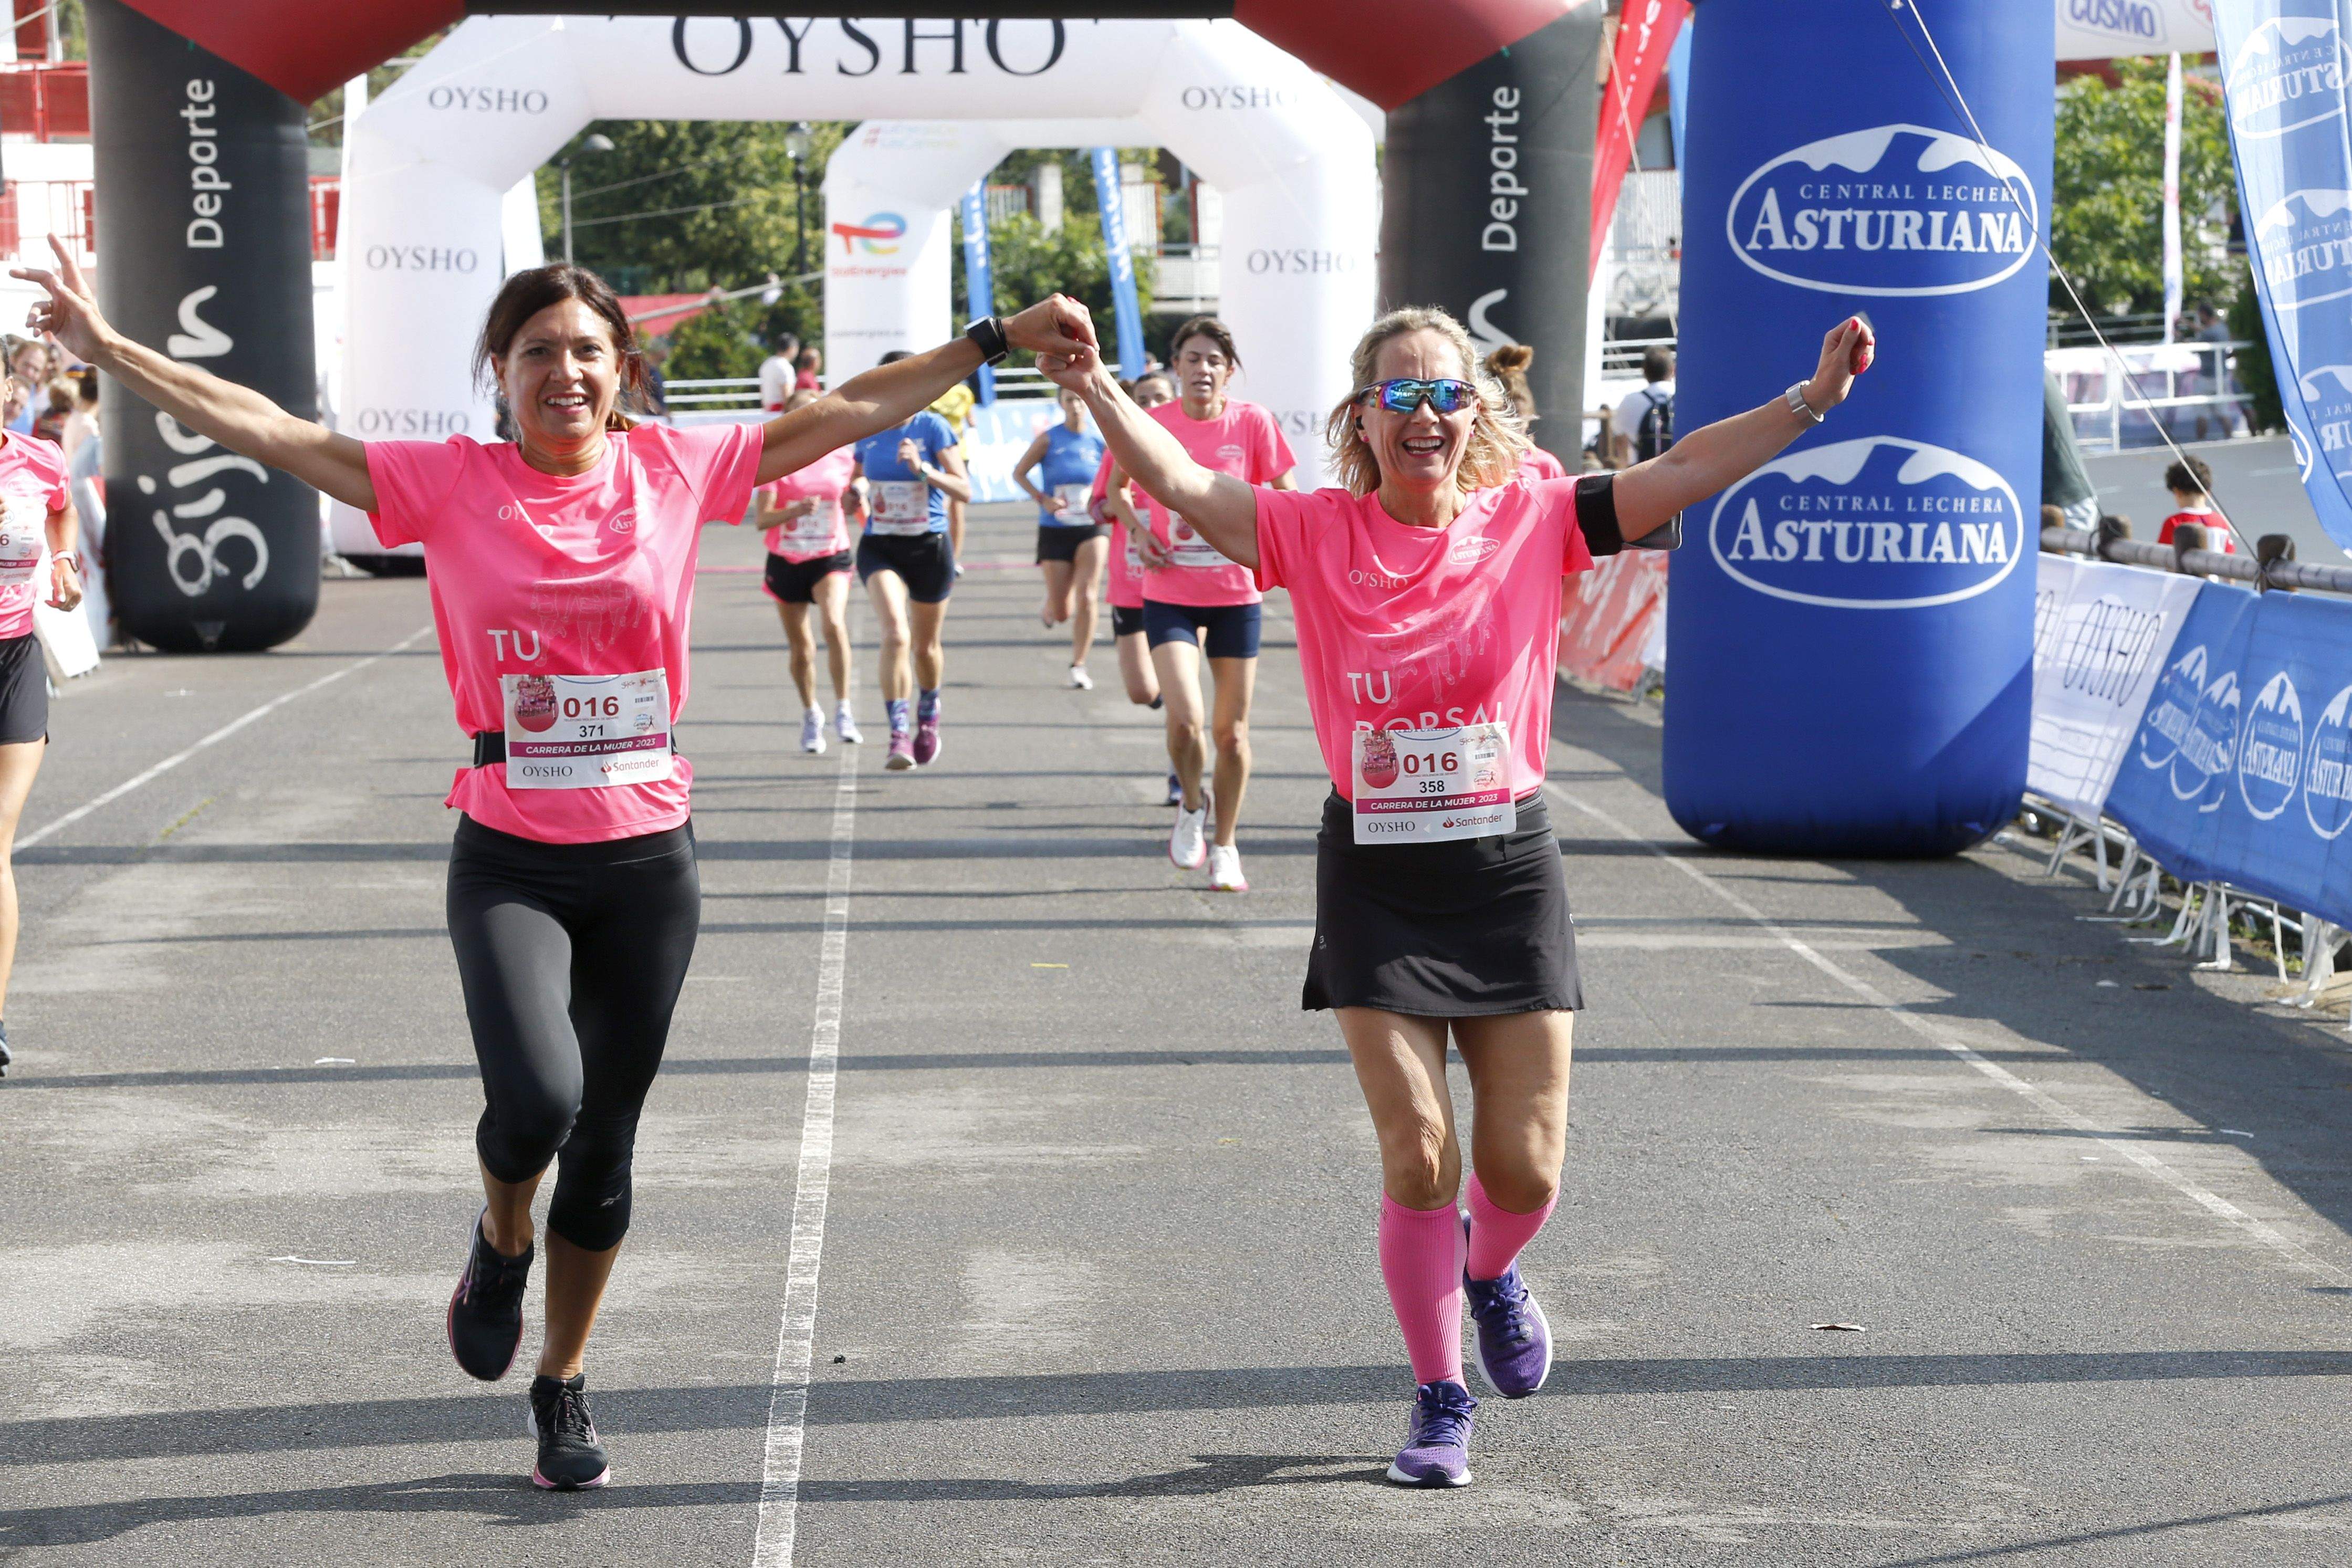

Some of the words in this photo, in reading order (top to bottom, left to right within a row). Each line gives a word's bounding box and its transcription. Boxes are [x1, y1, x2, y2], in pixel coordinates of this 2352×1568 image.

[672, 18, 1064, 76] OYSHO
[428, 86, 548, 113] OYSHO
[1182, 86, 1298, 111] OYSHO
[180, 79, 232, 248] Deporte
[1482, 86, 1529, 253] Deporte
[1800, 184, 1915, 201] CENTRAL
[1747, 187, 2024, 255] ASTURIANA
[367, 245, 478, 274] OYSHO
[1247, 248, 1355, 274] OYSHO
[359, 408, 469, 434] OYSHO
[1780, 495, 1895, 512] CENTRAL
[1908, 496, 2003, 515] LECHERA
[1728, 498, 2008, 565] ASTURIANA
[1349, 570, 1408, 589] OYSHO
[487, 629, 541, 662] TU
[2063, 599, 2161, 707] OYSHO
[1347, 671, 1392, 704] TU
[563, 696, 619, 718] 016
[579, 725, 604, 737] 371
[526, 745, 571, 754] CARRERA
[573, 744, 587, 752] DE
[589, 743, 601, 751] LA
[603, 741, 633, 751] MUJER
[636, 738, 656, 748] 2023
[522, 766, 573, 778] OYSHO
[613, 758, 660, 772] Santander
[1404, 752, 1458, 774] 016
[1419, 780, 1445, 793] 358
[1371, 801, 1414, 810] CARRERA
[1415, 800, 1429, 809] DE
[1430, 799, 1442, 808] LA
[1445, 797, 1476, 807] MUJER
[1479, 793, 1498, 802] 2023
[1368, 821, 1415, 833] OYSHO
[1456, 814, 1502, 827] Santander
